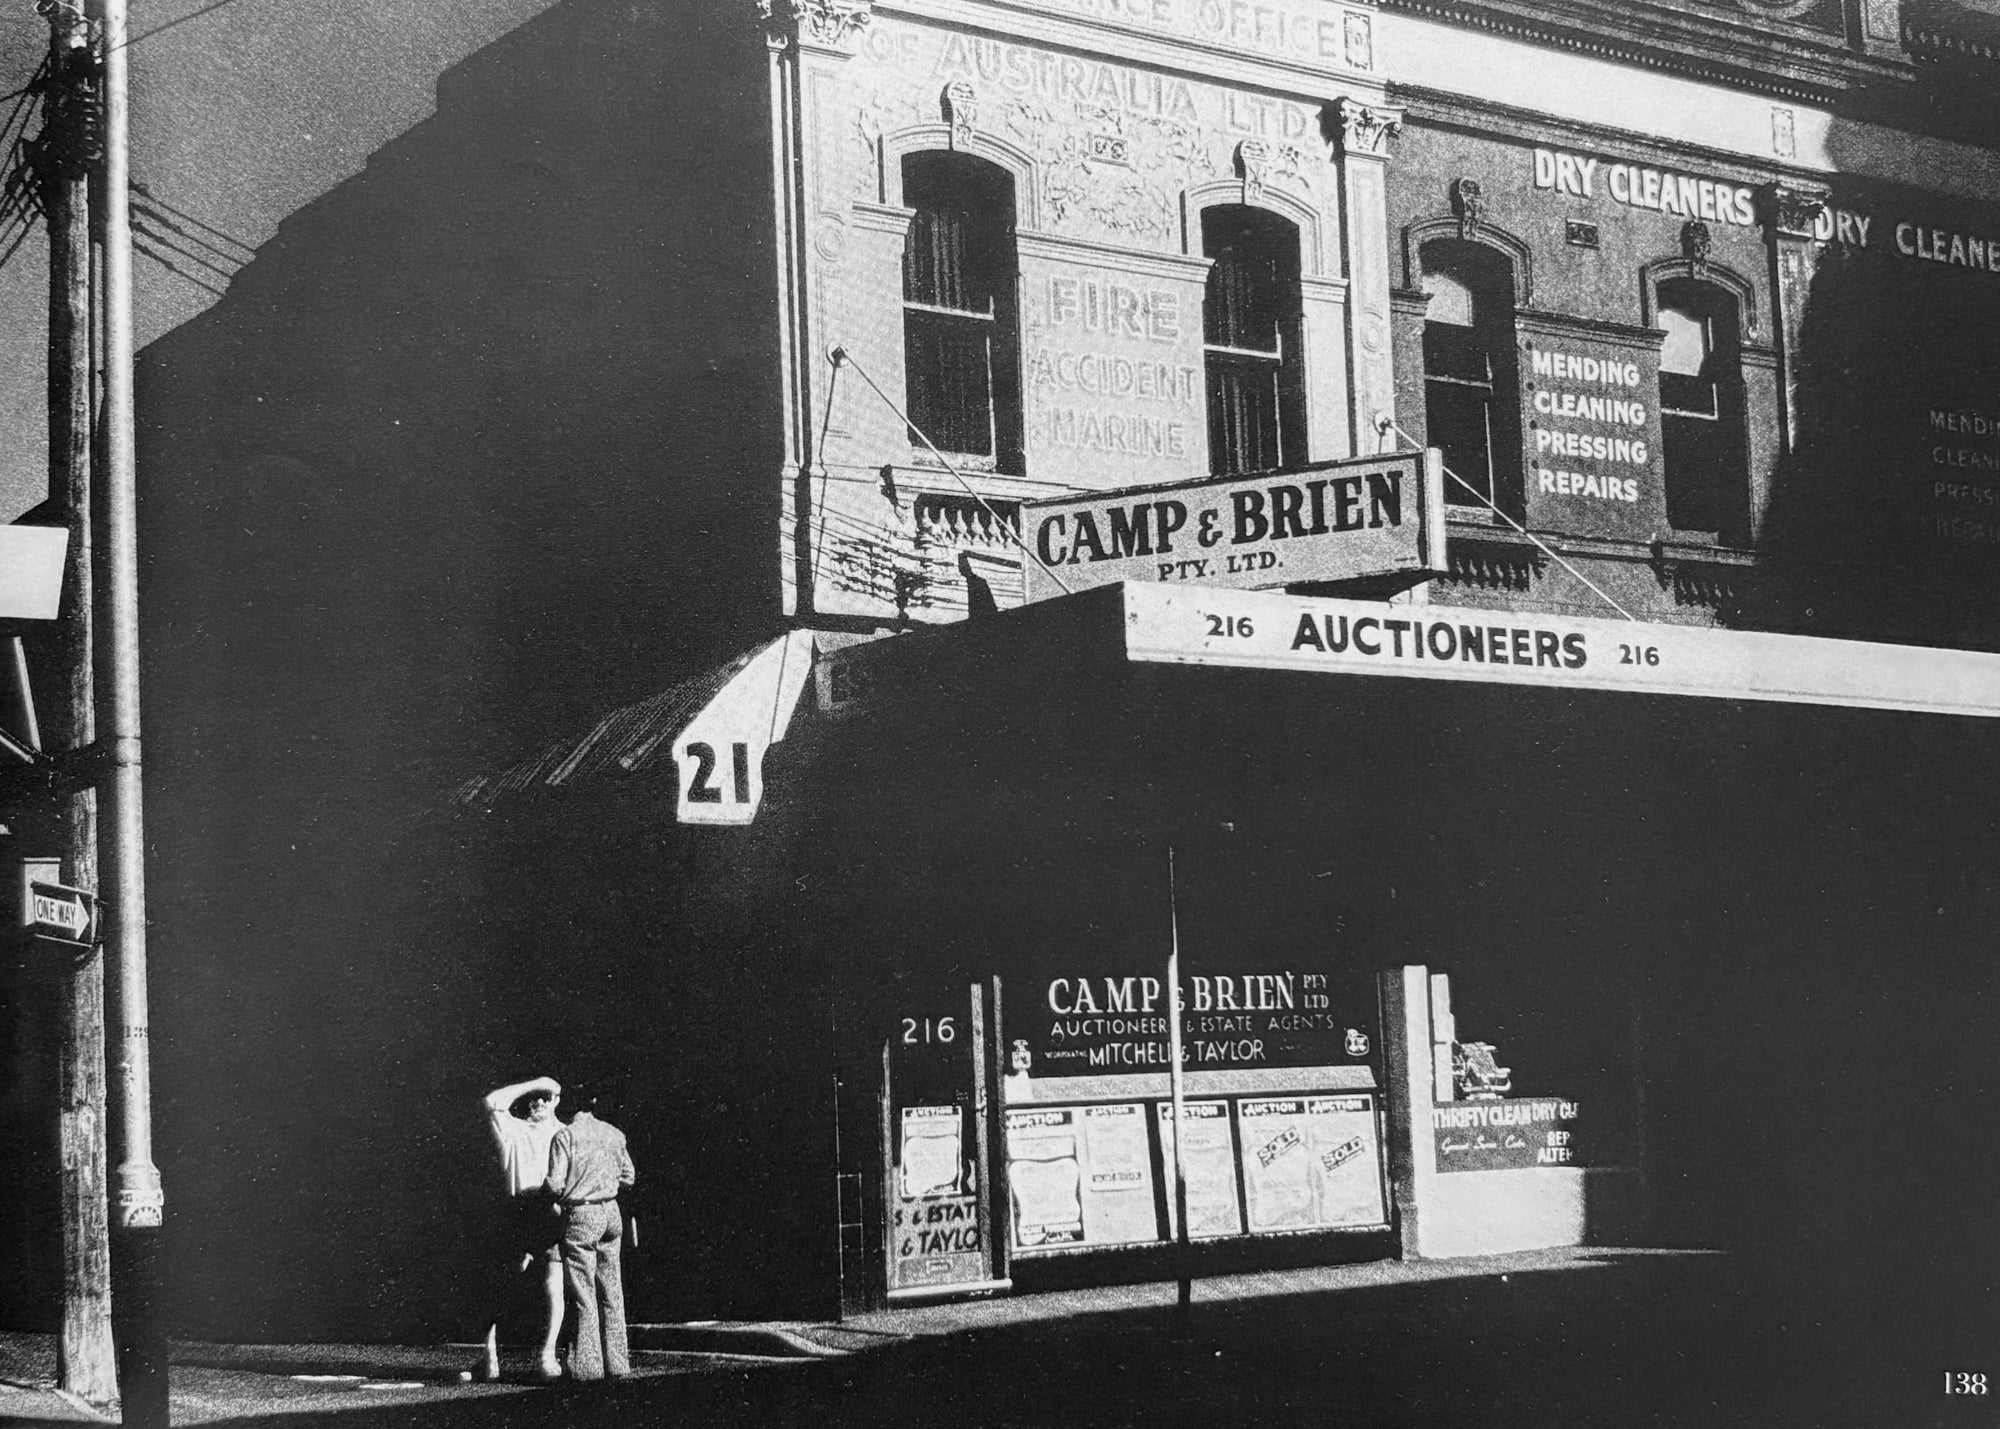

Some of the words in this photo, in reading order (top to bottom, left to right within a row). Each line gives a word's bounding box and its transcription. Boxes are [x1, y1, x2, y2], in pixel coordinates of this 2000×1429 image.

[1195, 0, 1337, 58] OFFICE
[931, 31, 1199, 121] AUSTRALIA
[1535, 148, 1596, 197] DRY
[1608, 163, 1755, 227] CLEANERS
[1815, 205, 1870, 247] DRY
[1896, 222, 2000, 272] CLEANE
[1051, 275, 1180, 344] FIRE
[1030, 348, 1197, 400] ACCIDENT
[1532, 350, 1641, 388] MENDING
[1534, 391, 1647, 426] CLEANING
[1051, 405, 1185, 459] MARINE
[1536, 429, 1648, 465] PRESSING
[1538, 469, 1639, 503] REPAIRS
[1037, 499, 1188, 567] CAMP
[1199, 509, 1223, 547] &
[1229, 469, 1403, 544] BRIEN
[1158, 559, 1216, 582] PTY.
[1228, 550, 1284, 574] LTD.
[1206, 614, 1254, 638] 216
[1291, 612, 1588, 670] AUCTIONEERS
[1619, 644, 1660, 667] 216
[686, 741, 751, 804] 21
[37, 899, 55, 922] ONE
[58, 904, 76, 926] WAY
[1048, 977, 1161, 1014] CAMP
[1191, 973, 1295, 1011] BRIEN
[1304, 994, 1330, 1009] LTD
[901, 1017, 955, 1043] 216
[1186, 1019, 1194, 1033] &
[1201, 1016, 1253, 1032] ESTATE
[1268, 1013, 1335, 1030] AGENTS
[1193, 1039, 1266, 1061] TAYLOR
[1006, 1111, 1065, 1129] AUCTION
[1243, 1102, 1297, 1117] AUCTION
[1311, 1100, 1363, 1115] AUCTION
[1531, 1102, 1557, 1121] DRY
[1257, 1126, 1301, 1166] SOLD
[1323, 1137, 1364, 1167] SOLD
[918, 1226, 979, 1254] TAYLO
